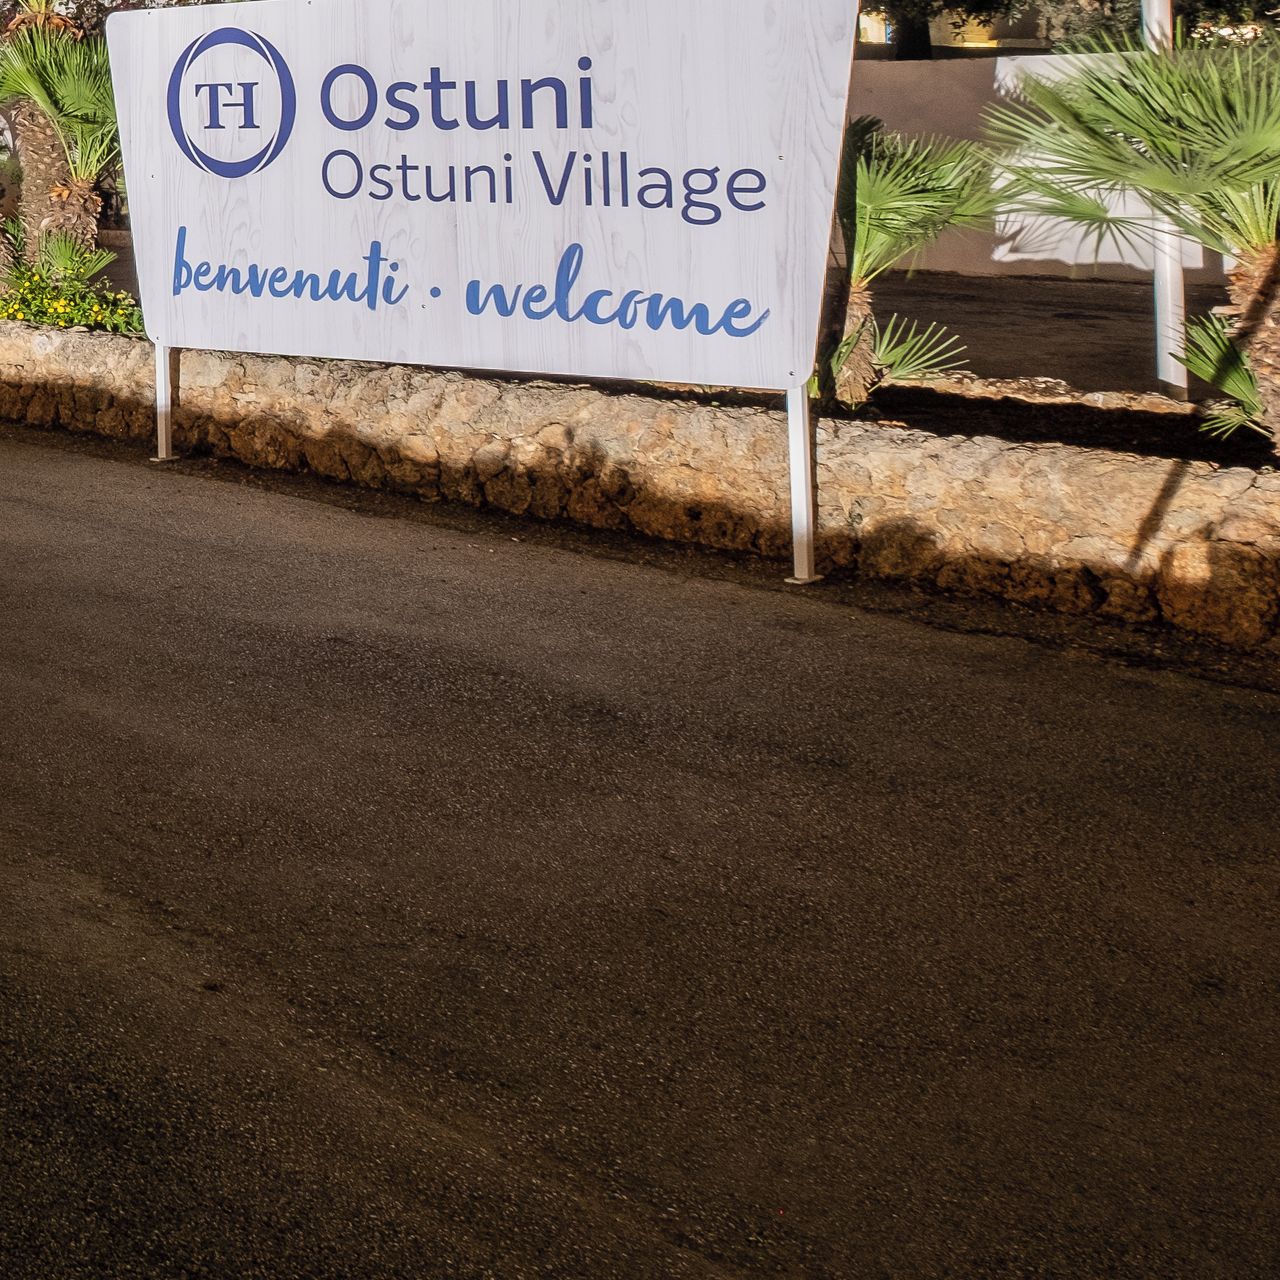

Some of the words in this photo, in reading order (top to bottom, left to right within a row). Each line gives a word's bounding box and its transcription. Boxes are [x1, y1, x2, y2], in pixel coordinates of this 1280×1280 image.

[194, 81, 260, 130] TH
[321, 56, 593, 132] Ostuni
[321, 150, 513, 203] Ostuni
[532, 152, 767, 225] Village
[172, 225, 410, 312] benvenuti
[465, 242, 770, 338] welcome
